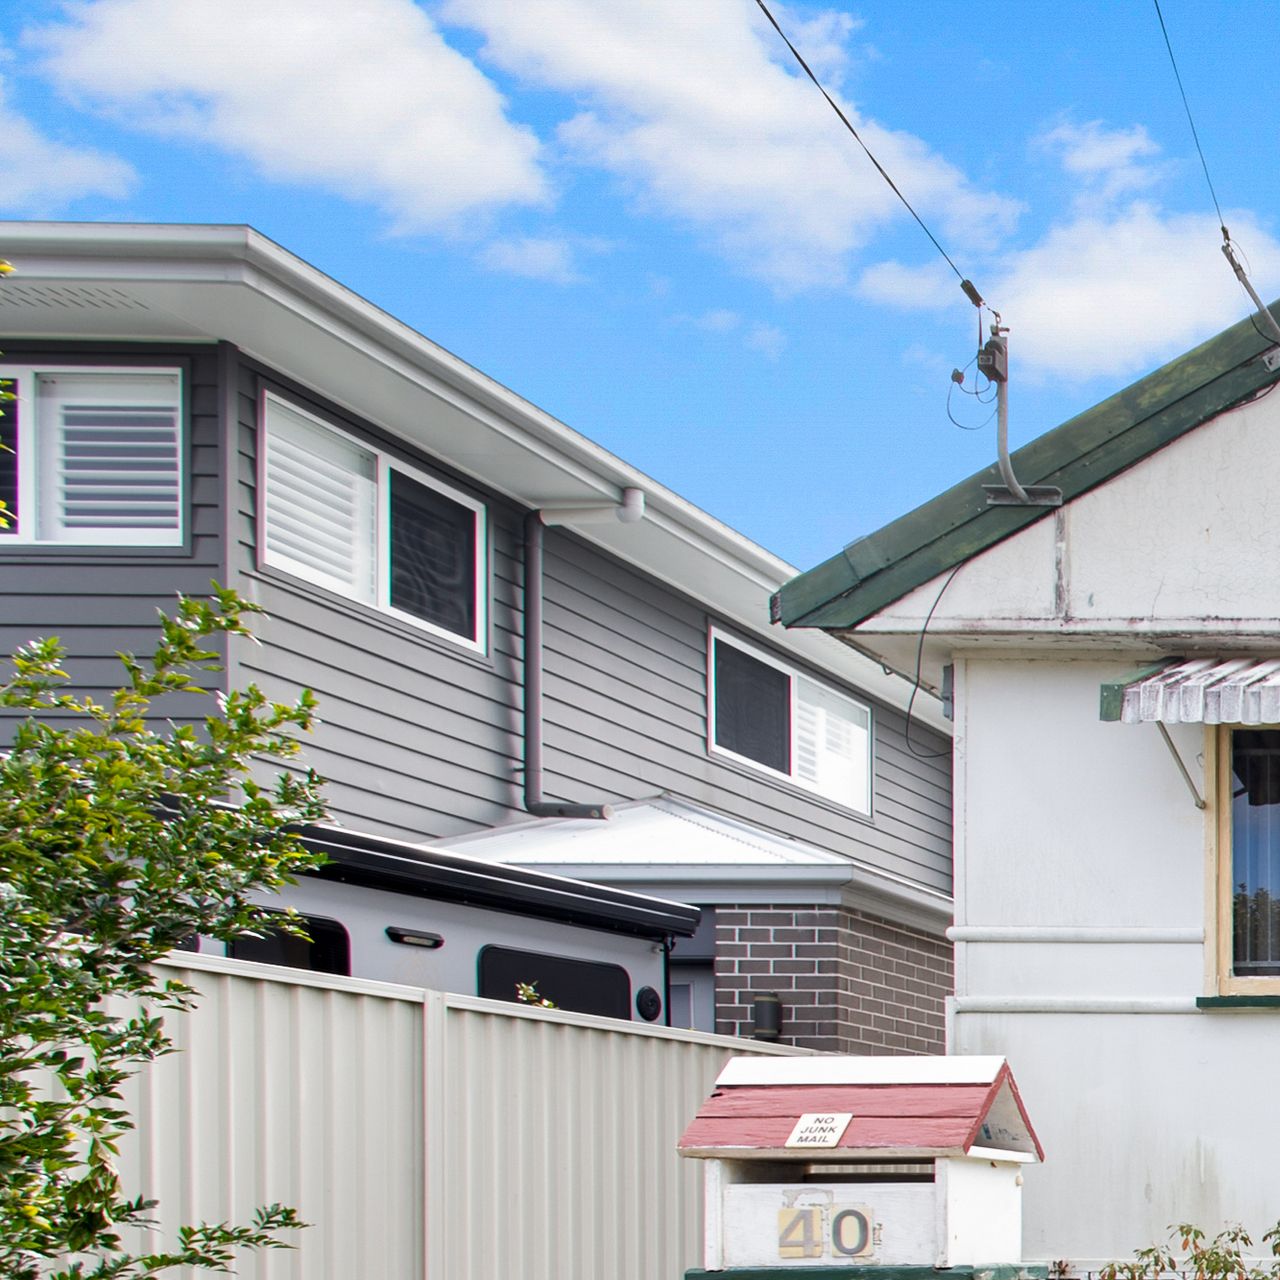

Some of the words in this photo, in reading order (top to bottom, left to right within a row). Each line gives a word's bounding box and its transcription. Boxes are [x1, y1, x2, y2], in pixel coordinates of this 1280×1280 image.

[800, 1126, 838, 1134] JUNK
[796, 1135, 829, 1143] MAIL
[779, 1209, 869, 1257] 40
